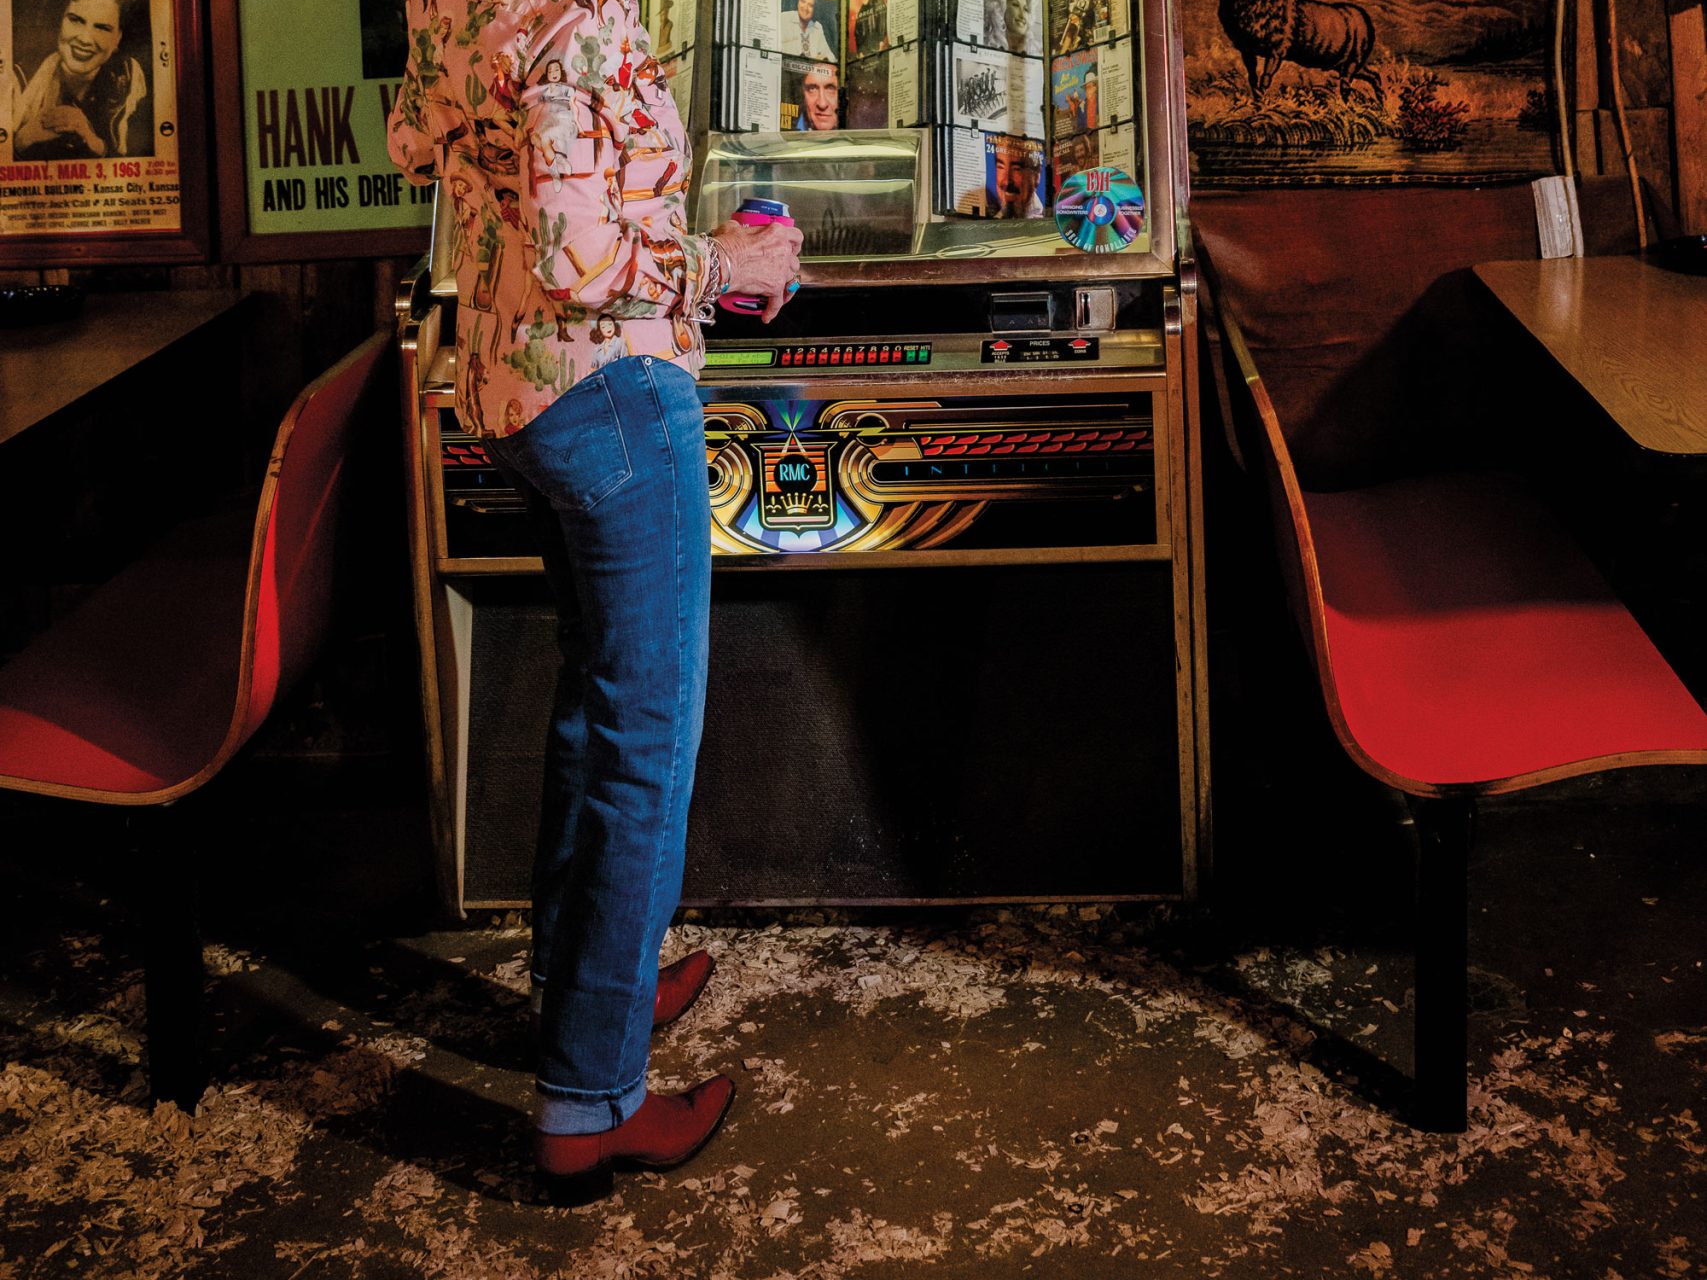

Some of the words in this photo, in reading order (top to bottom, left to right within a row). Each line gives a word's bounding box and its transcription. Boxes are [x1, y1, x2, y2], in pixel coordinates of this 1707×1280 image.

[791, 63, 815, 73] BIGGEST
[256, 85, 361, 169] HANK
[986, 144, 995, 154] 24
[57, 163, 91, 181] MAR.
[113, 161, 141, 178] 1963
[44, 183, 84, 195] BUILDING
[93, 182, 124, 194] Kansas
[1086, 171, 1110, 192] BMI
[72, 199, 91, 208] Call
[103, 197, 116, 207] All
[118, 196, 147, 206] Seats
[149, 195, 180, 205] $2.50
[263, 179, 306, 211] AND
[315, 176, 350, 209] HIS
[1065, 229, 1081, 248] SEAL
[1083, 243, 1092, 252] OF
[1095, 226, 1137, 254] COMPLIANCE
[778, 464, 811, 482] RMC
